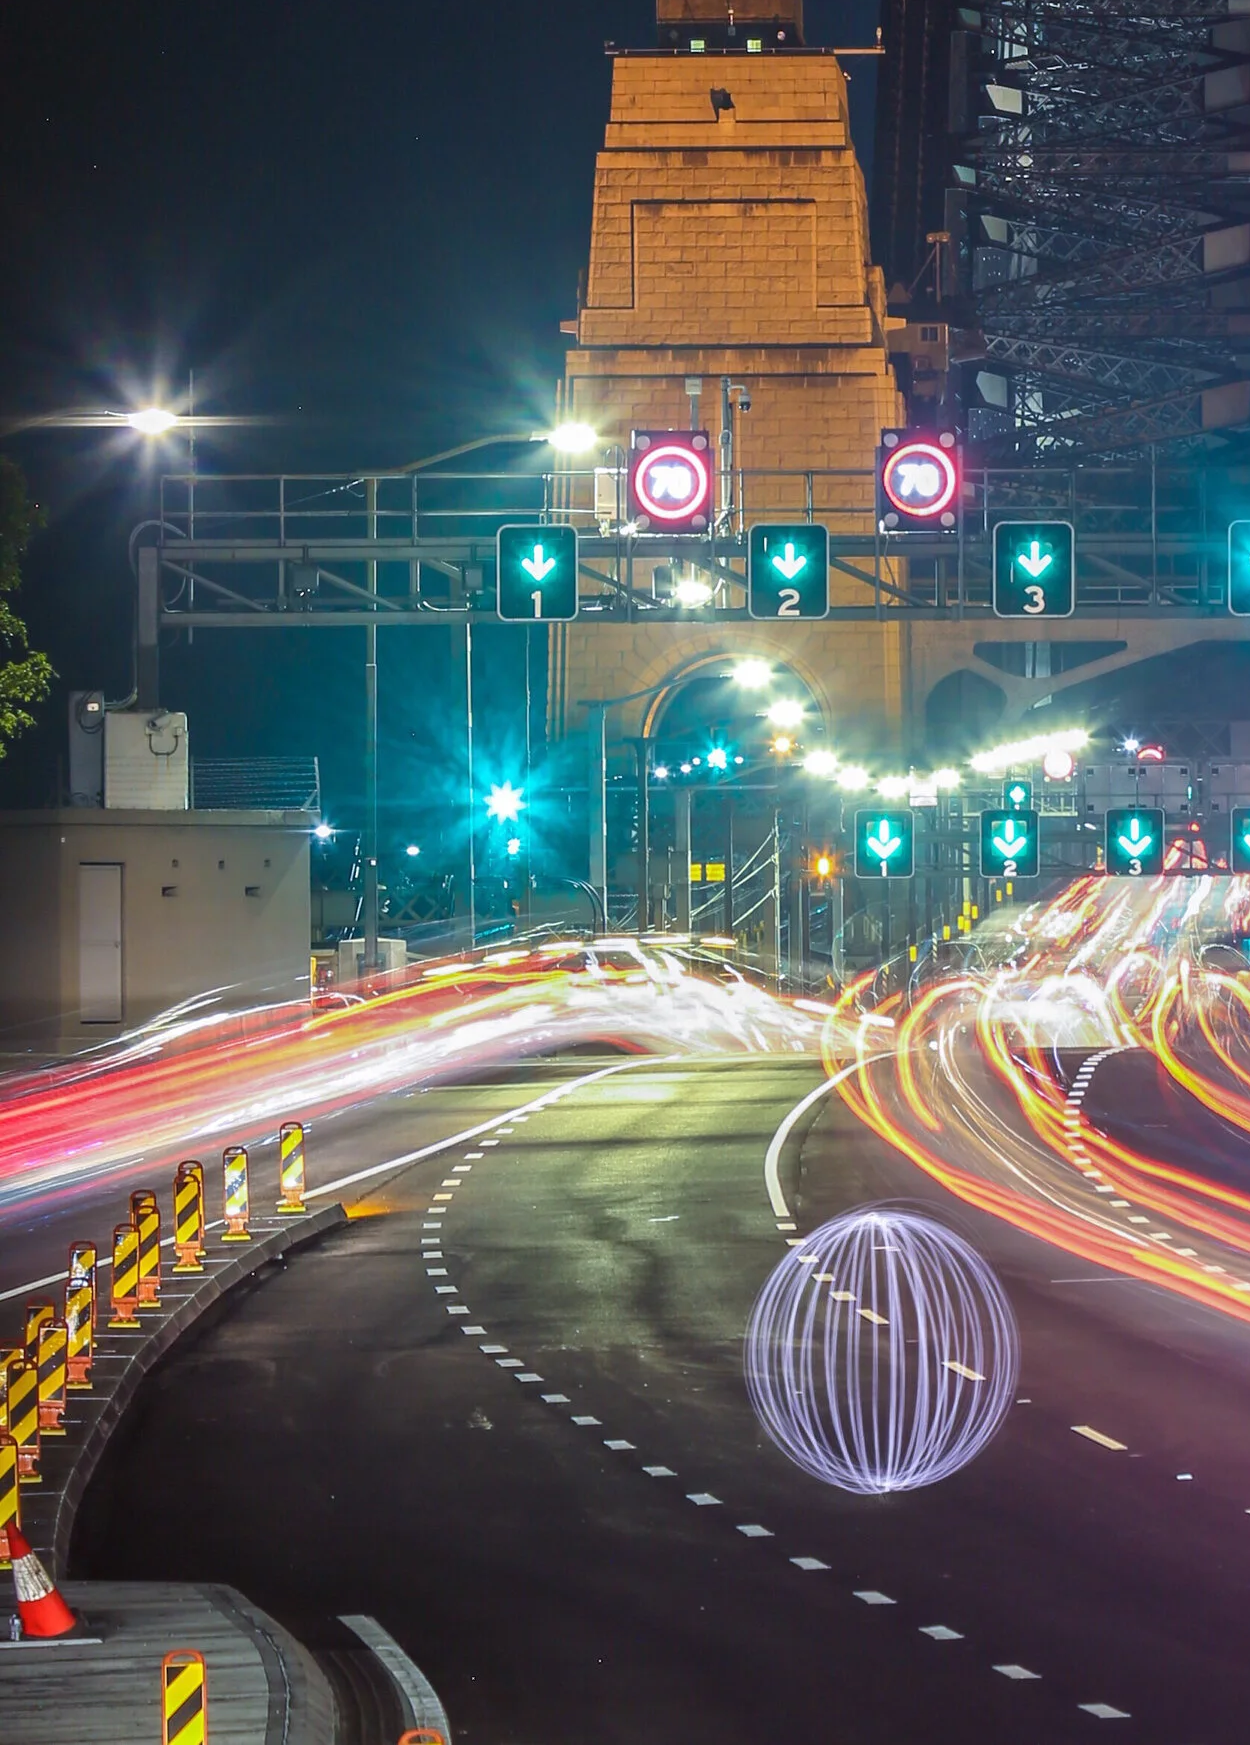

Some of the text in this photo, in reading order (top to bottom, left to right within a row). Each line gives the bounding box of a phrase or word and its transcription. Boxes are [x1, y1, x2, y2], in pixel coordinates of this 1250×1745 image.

[649, 465, 691, 499] 70
[897, 463, 939, 497] 70
[531, 590, 541, 618] 1
[777, 588, 800, 616] 2
[1023, 585, 1045, 614] 3
[879, 860, 887, 877] 1
[1003, 859, 1017, 877] 2
[1128, 859, 1142, 876] 3
